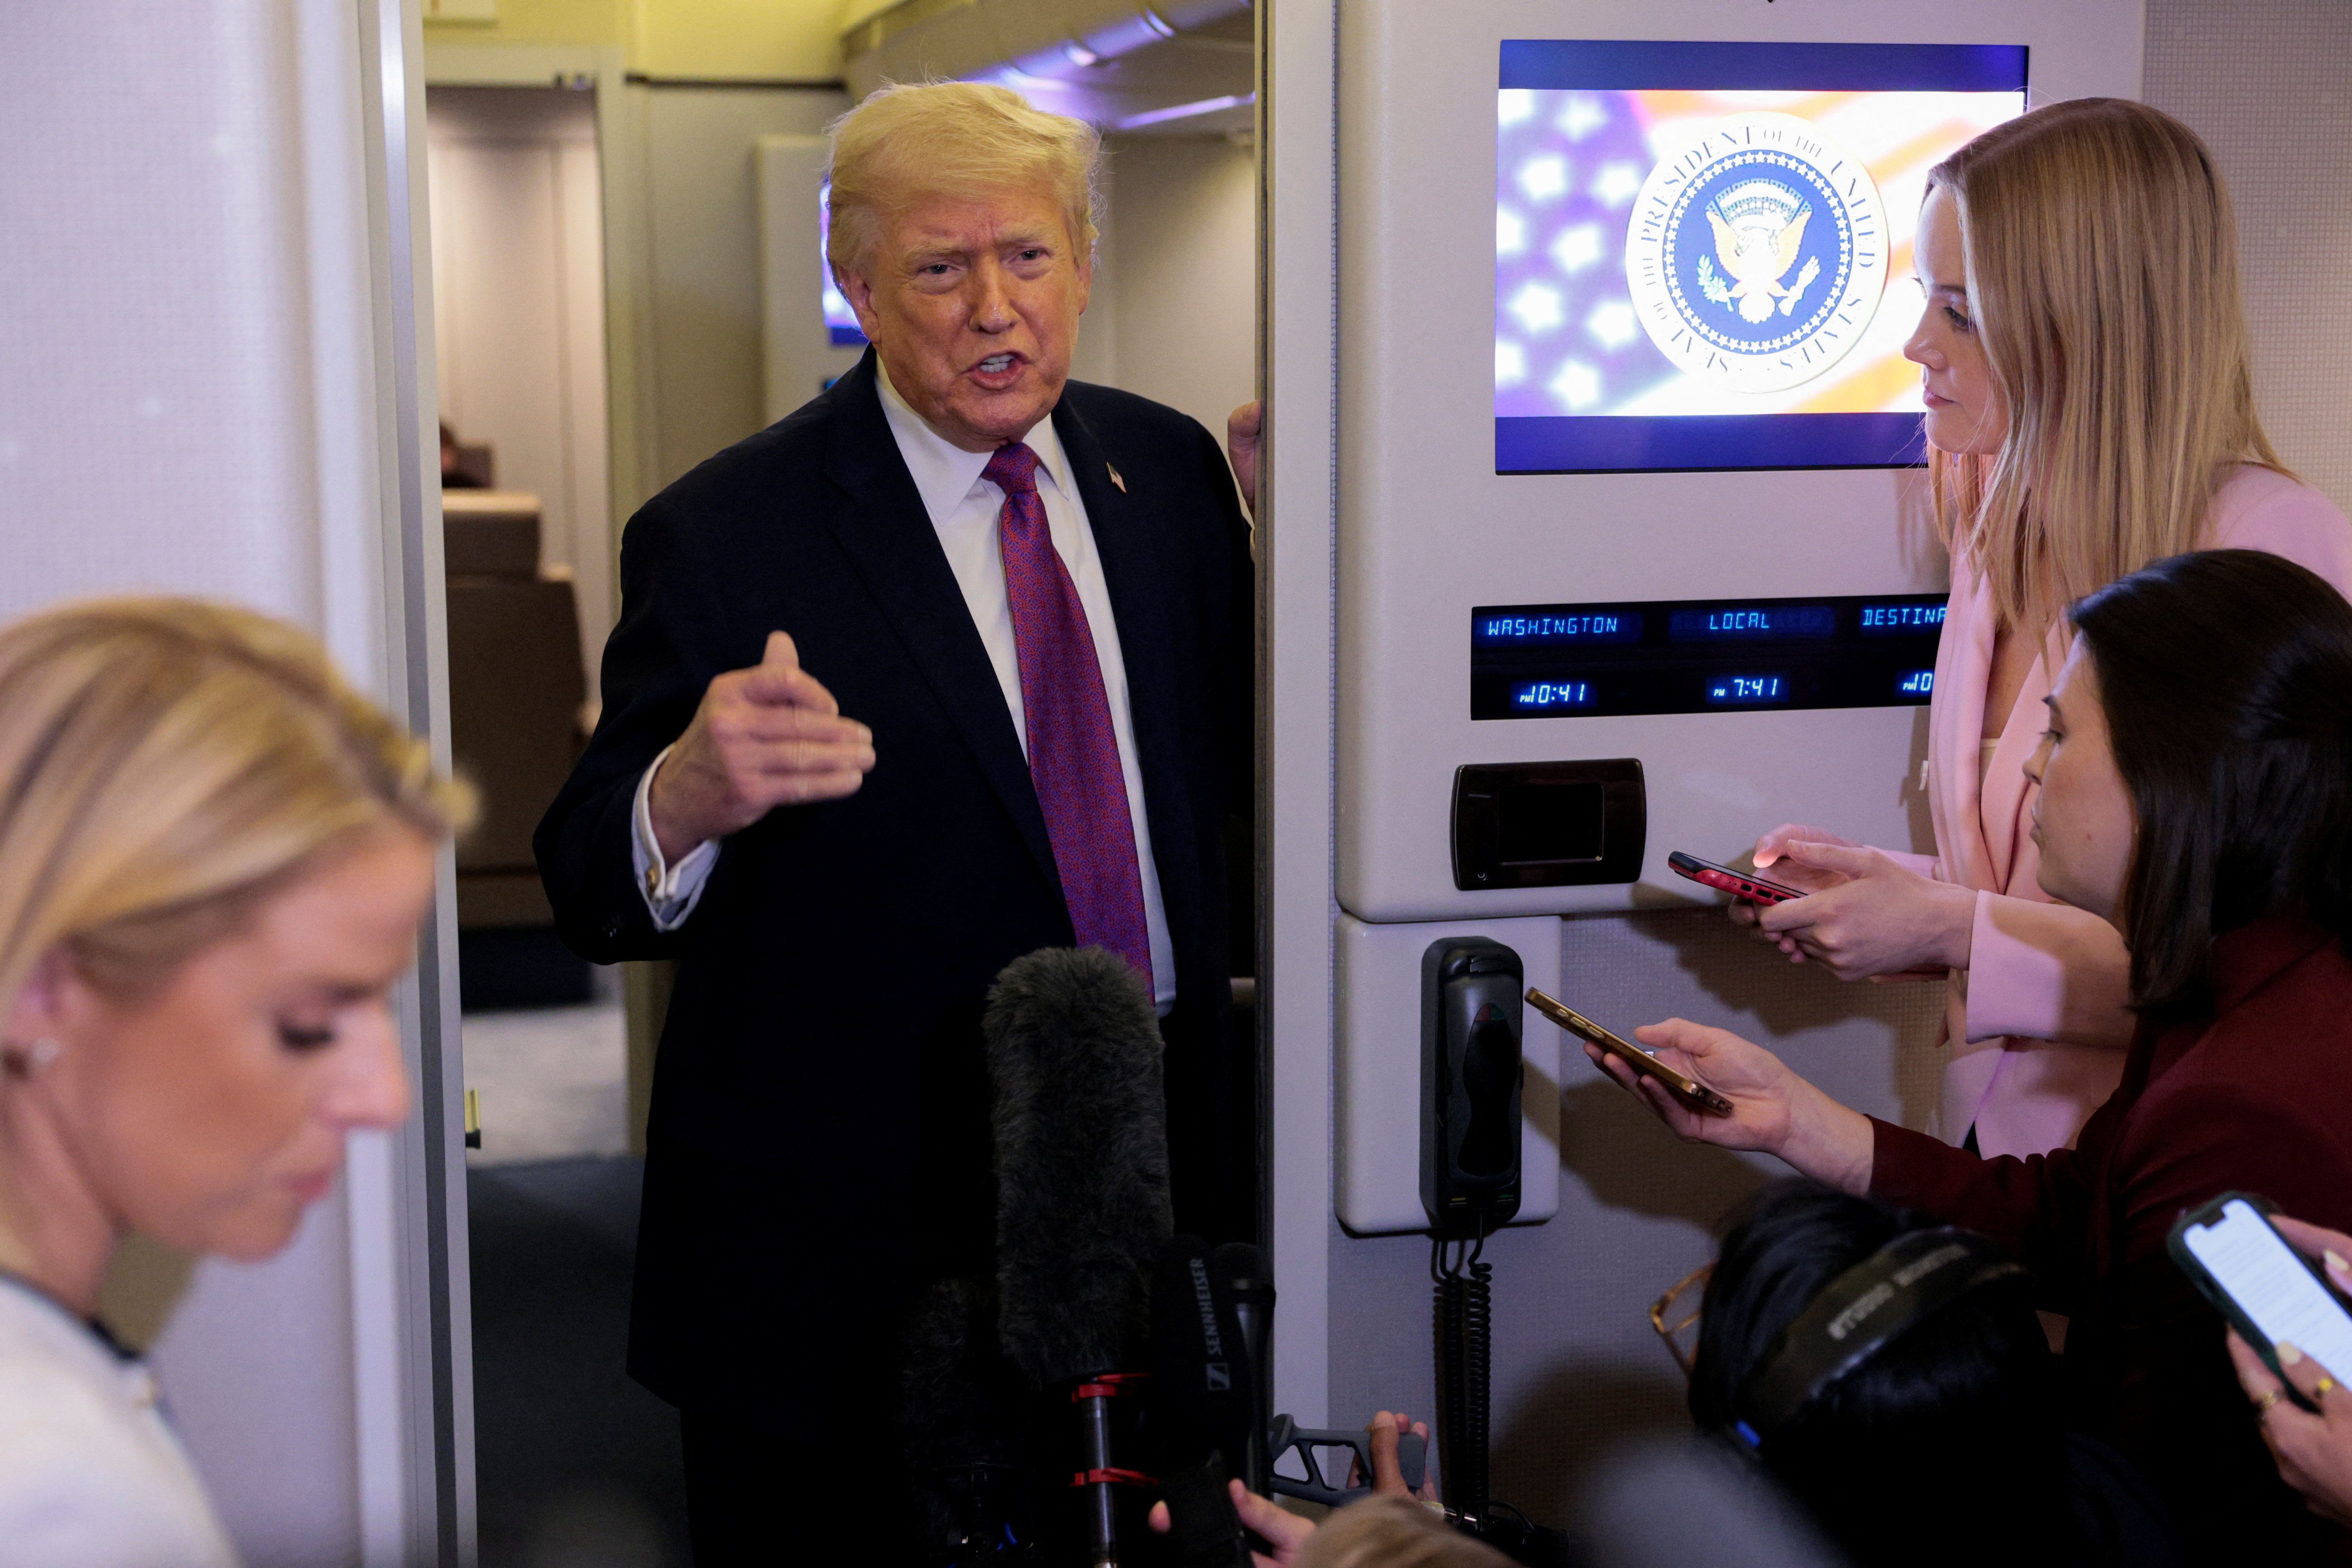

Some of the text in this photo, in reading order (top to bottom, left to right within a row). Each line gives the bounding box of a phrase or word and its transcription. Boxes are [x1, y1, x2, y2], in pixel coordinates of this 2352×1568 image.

[1641, 126, 1755, 242] PRESIDENT
[1488, 618, 1617, 635] WASHINGTON
[1710, 613, 1769, 629] LOCAL
[1531, 684, 1585, 703] 10:41
[1734, 678, 1778, 696] 7:41
[1190, 1258, 1222, 1356] SENNHEISER
